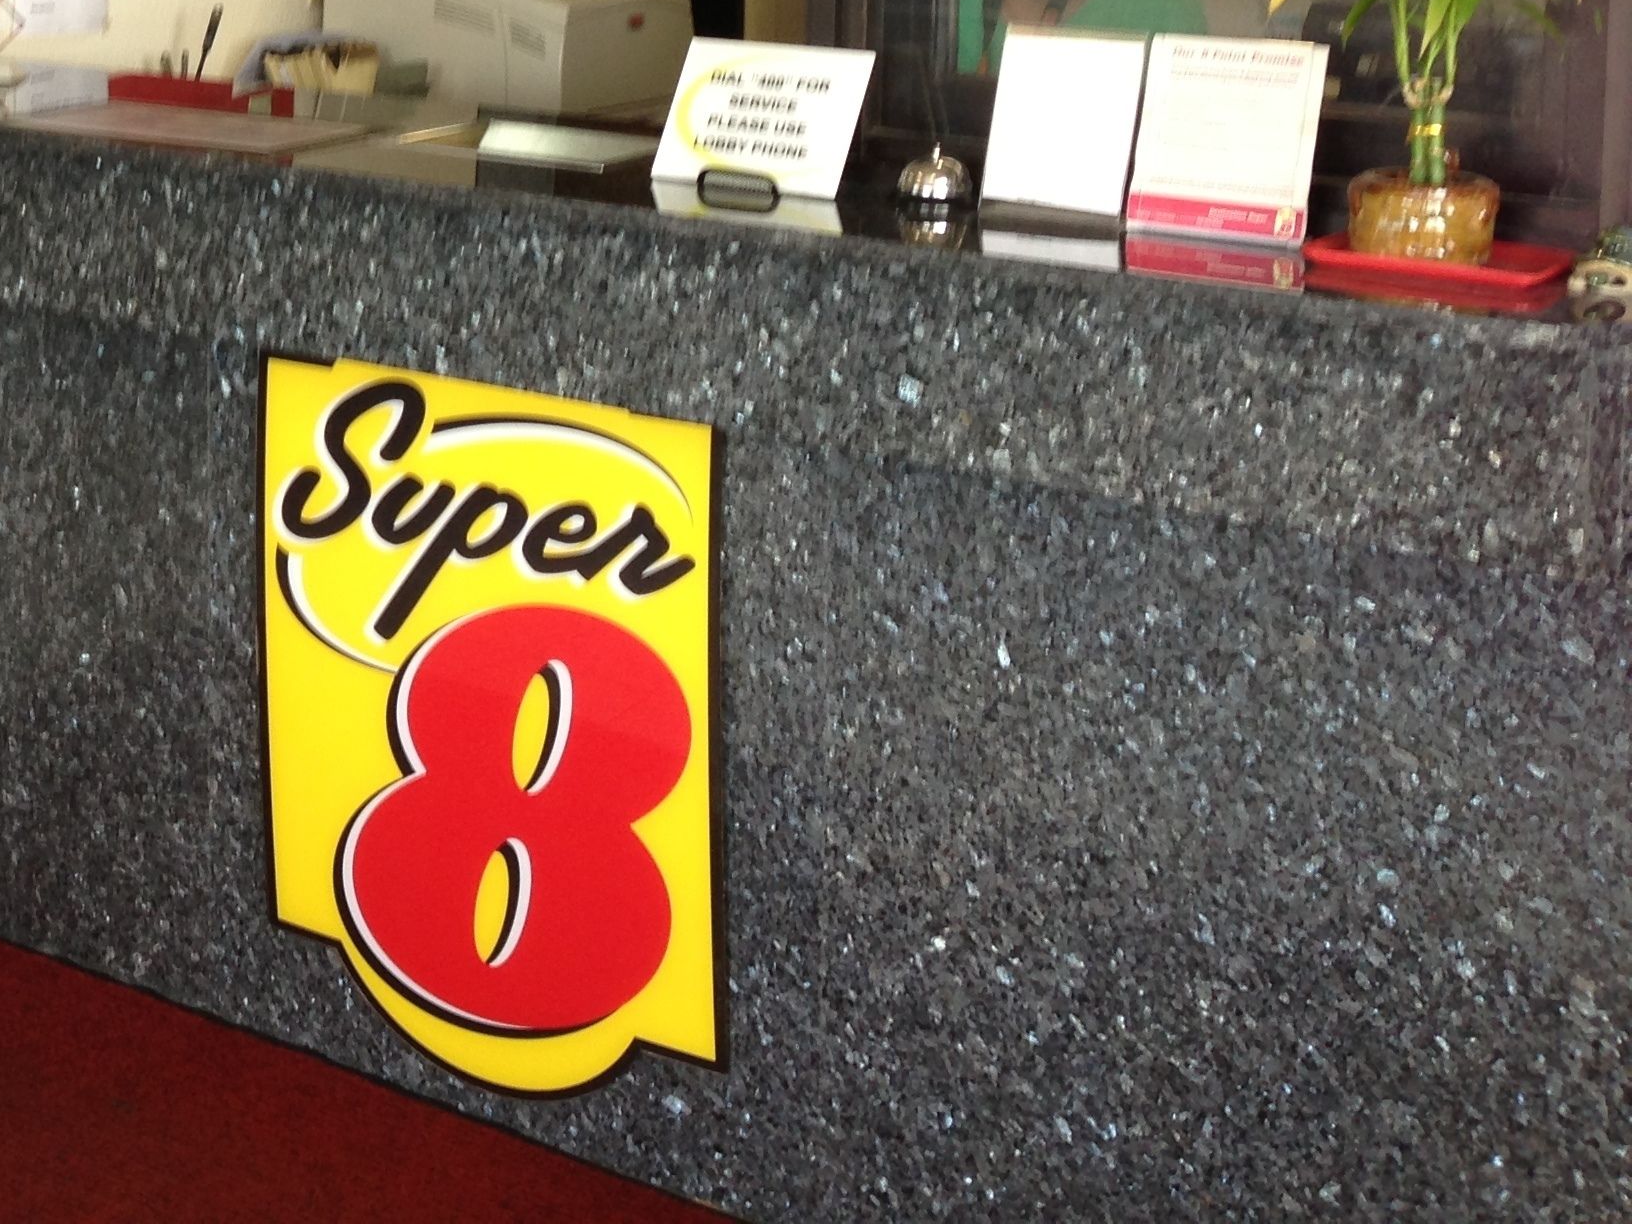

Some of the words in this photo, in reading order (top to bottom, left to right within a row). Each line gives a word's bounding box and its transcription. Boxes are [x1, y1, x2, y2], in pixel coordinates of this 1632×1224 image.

[710, 69, 744, 87] DIAL
[796, 77, 831, 94] FOR
[729, 93, 798, 114] SERVICE
[708, 113, 770, 133] PLEASE
[774, 120, 807, 137] USE
[693, 134, 748, 153] LOBBY
[751, 141, 809, 160] PHONE
[279, 377, 696, 640] Super
[333, 603, 692, 1038] 8
